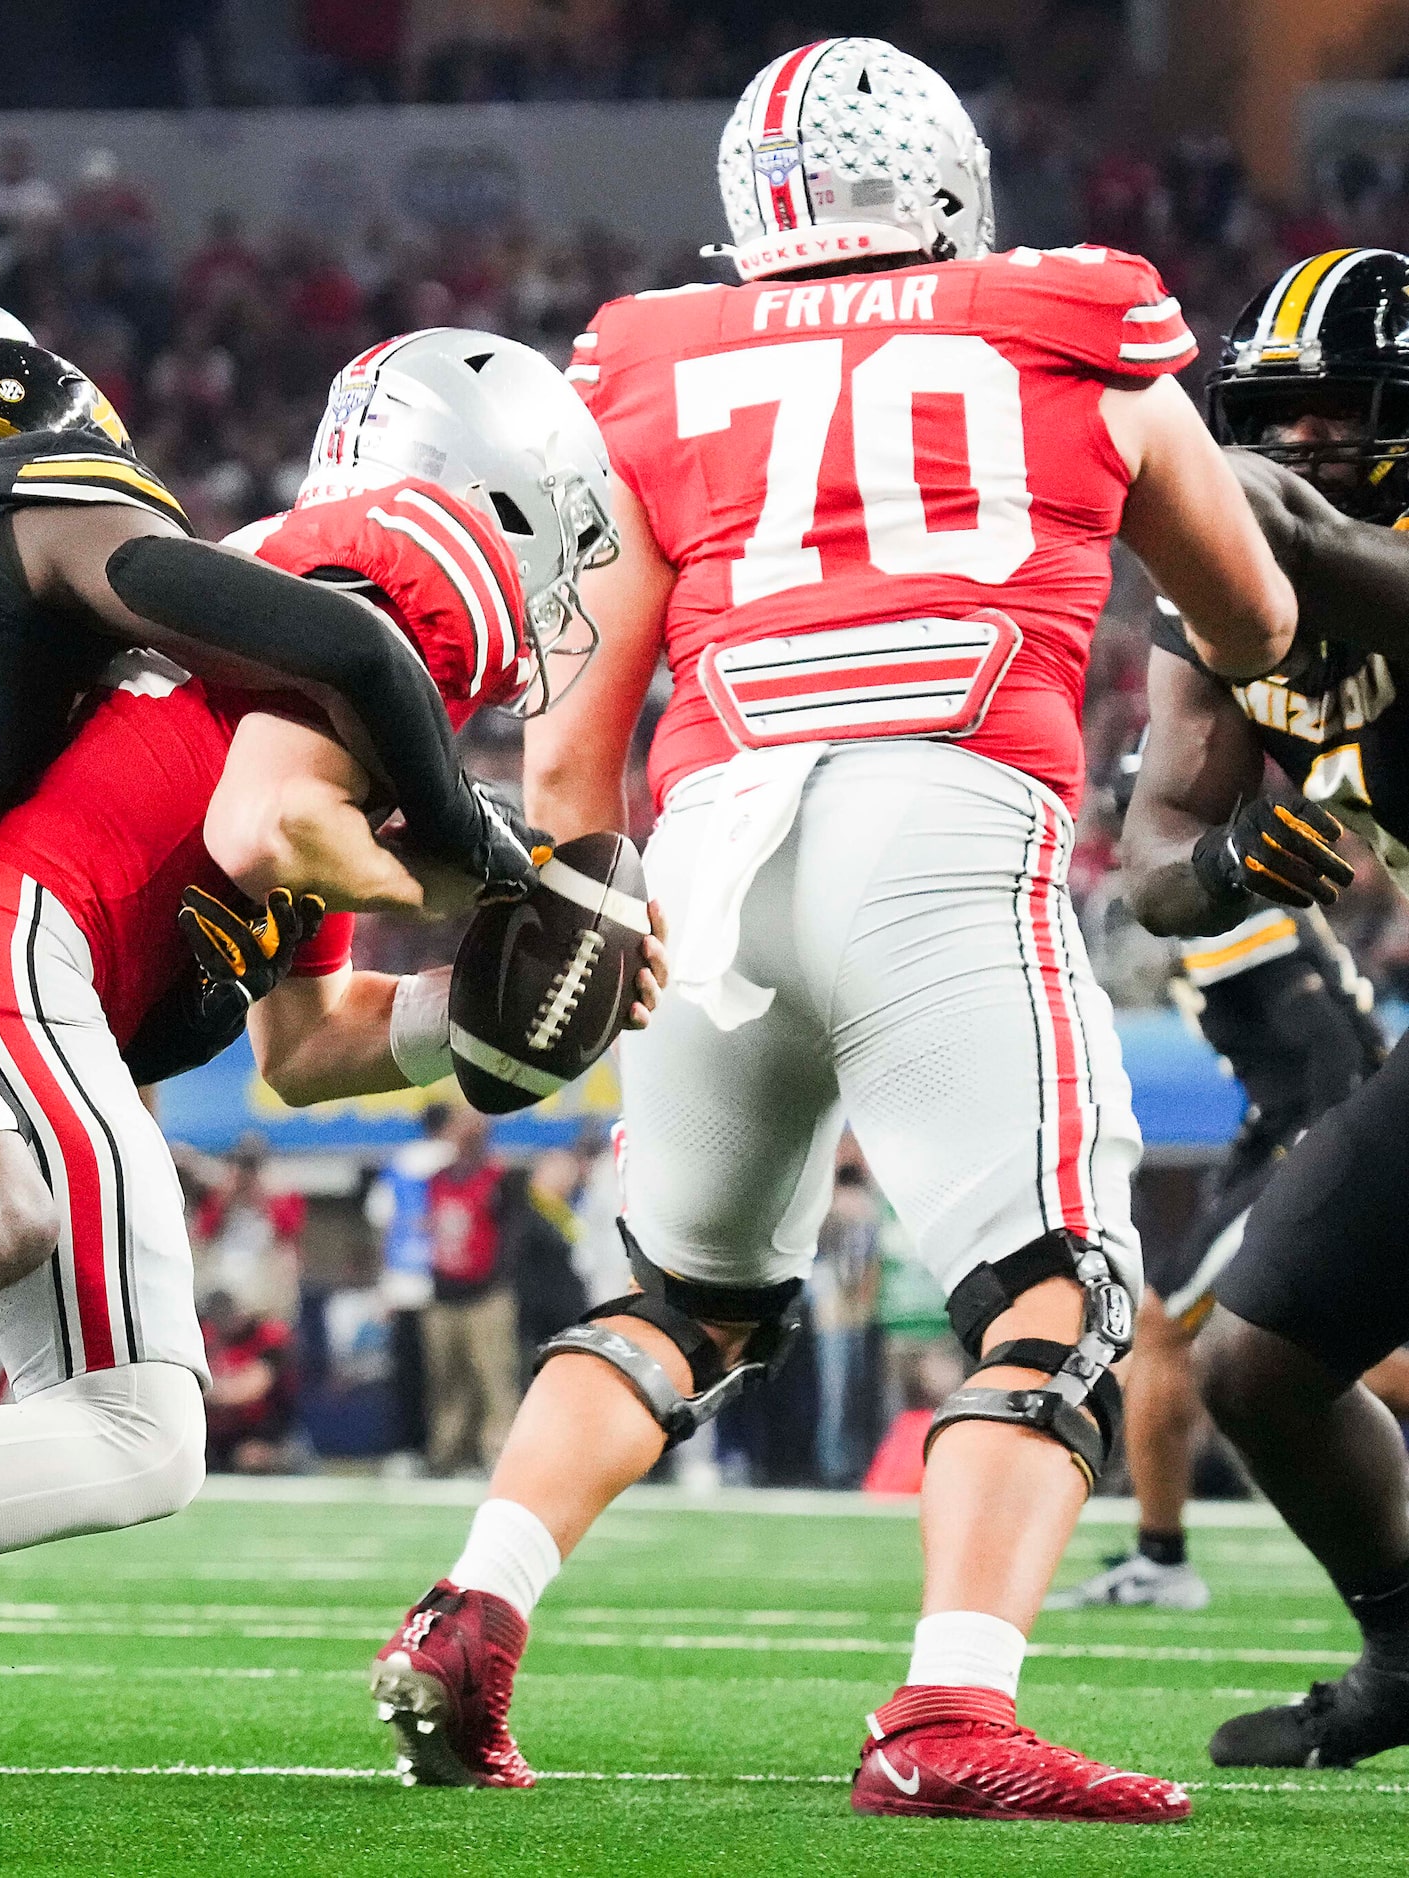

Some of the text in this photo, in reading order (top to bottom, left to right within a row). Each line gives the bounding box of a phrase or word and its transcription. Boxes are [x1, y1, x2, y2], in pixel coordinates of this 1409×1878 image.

[814, 189, 835, 206] 70
[741, 235, 870, 269] BUCKEYES
[753, 275, 938, 331] FRYAR
[674, 334, 1037, 607] 70
